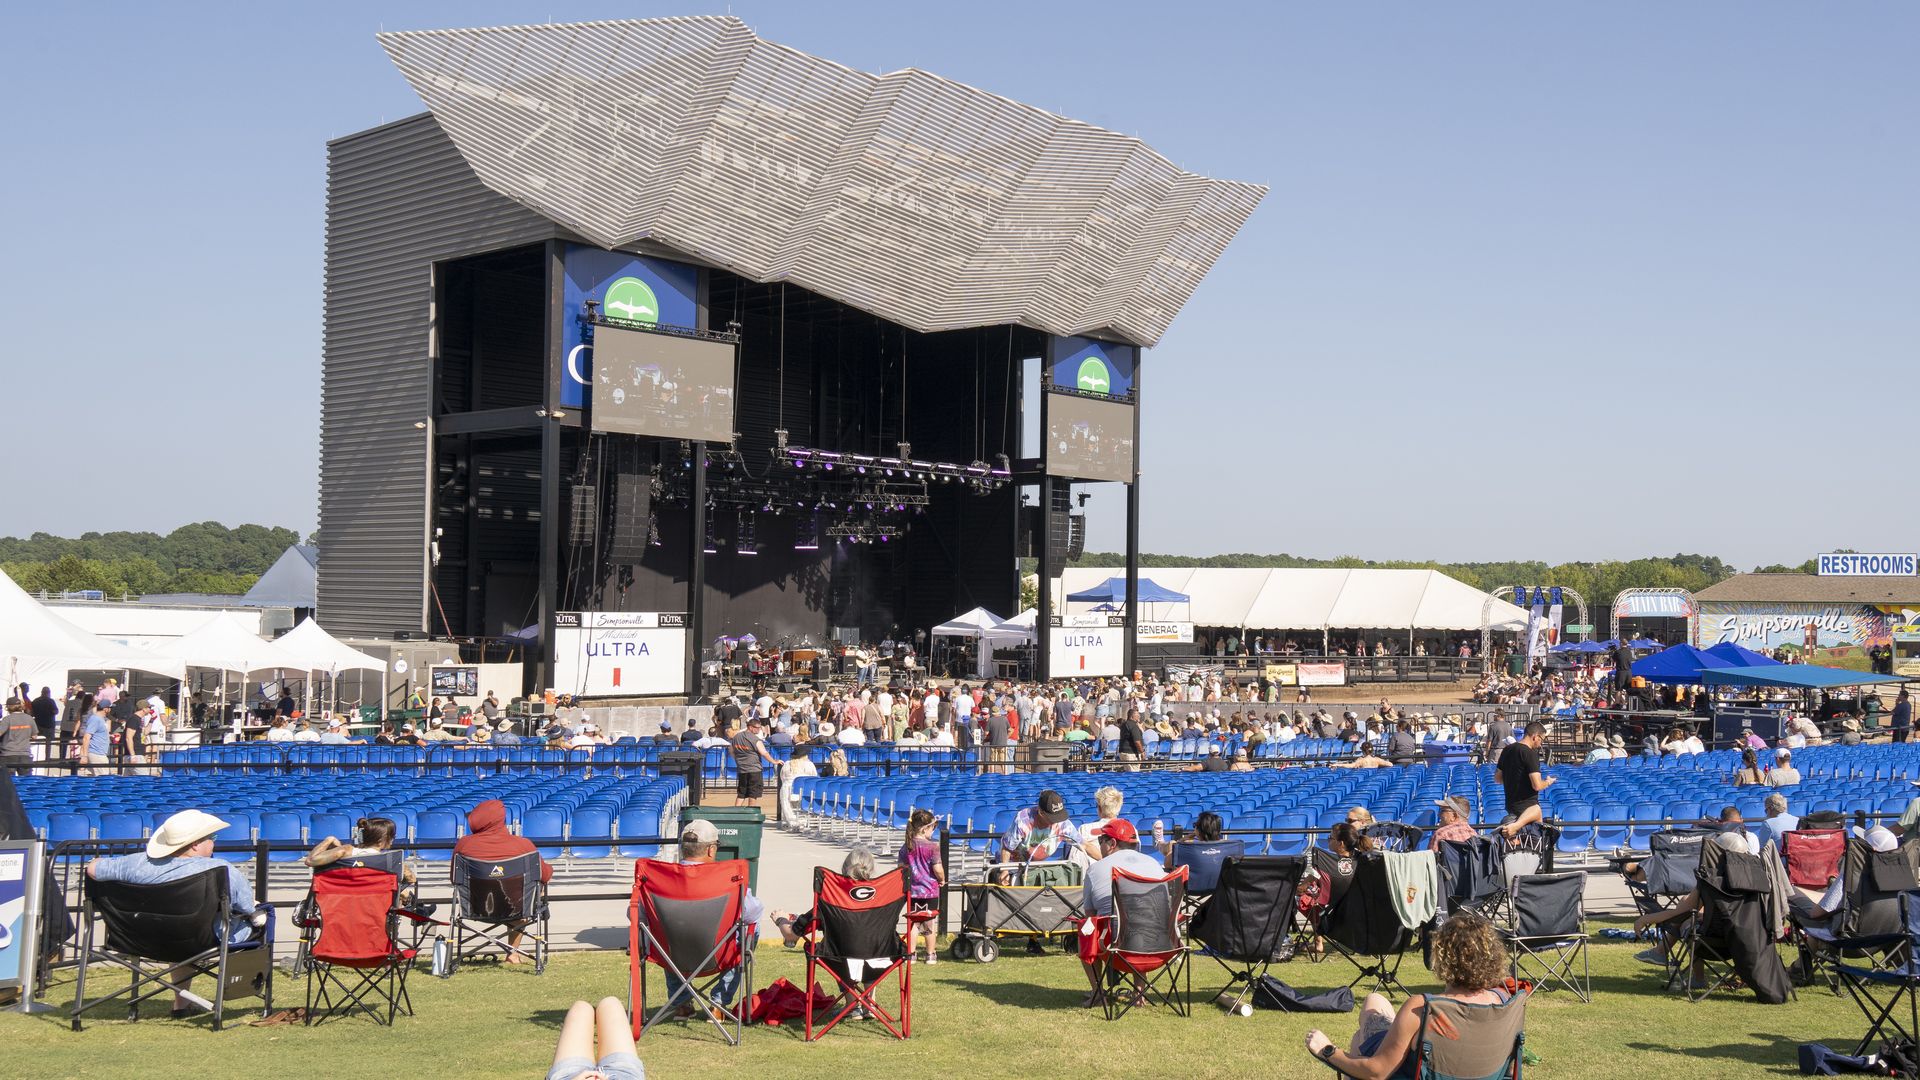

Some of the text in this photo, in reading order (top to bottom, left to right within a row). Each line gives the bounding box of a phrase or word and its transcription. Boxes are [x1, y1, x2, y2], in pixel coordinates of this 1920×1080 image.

[1821, 556, 1913, 574] RESTROOMS
[1630, 596, 1681, 613] MAIN BAR
[597, 614, 644, 627] Simpsonville
[1718, 607, 1849, 644] Simpsonville
[1138, 625, 1178, 634] GENERAC
[1064, 636, 1103, 647] ULTRA
[586, 642, 650, 656] ULTRA
